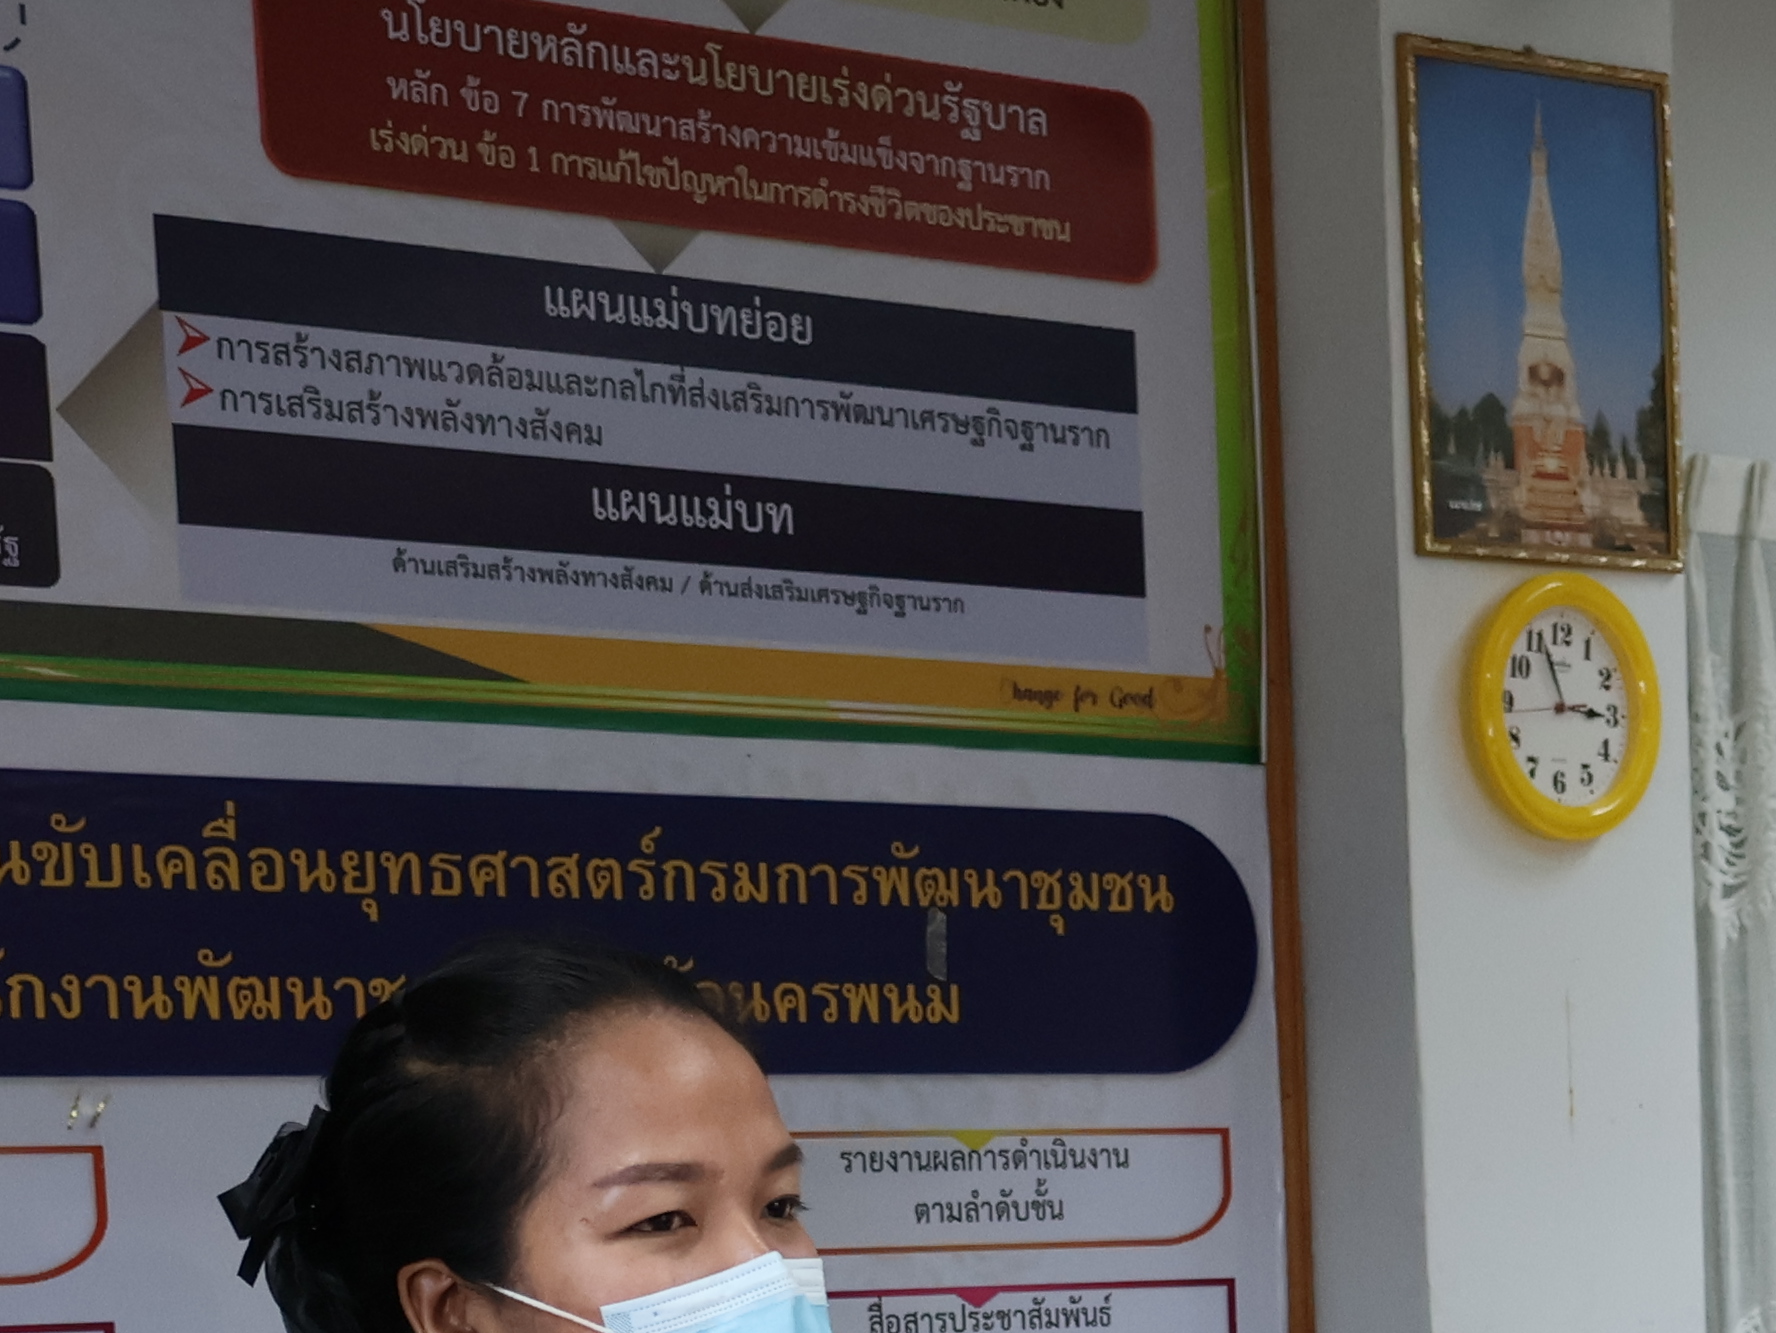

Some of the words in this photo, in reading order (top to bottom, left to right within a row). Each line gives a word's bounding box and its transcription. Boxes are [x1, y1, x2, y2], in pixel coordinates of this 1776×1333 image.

[387, 70, 449, 110] หลัก
[460, 78, 500, 116] ข้อ
[513, 90, 529, 118] 7
[369, 122, 468, 167] เร่งด่วน
[476, 130, 516, 170] ข้อ
[528, 146, 539, 173] 1
[542, 279, 815, 346] แผนแม่บทย่อย
[219, 380, 604, 448] การเสริมสร้างพลังทางสังคม
[591, 482, 794, 537] แผนแม่บท
[1550, 621, 1574, 647] 12
[1509, 653, 1532, 680] 10
[1598, 666, 1613, 692] 2
[1605, 703, 1619, 729] 3
[1596, 737, 1611, 763] 4
[1552, 768, 1567, 795] 6
[1579, 762, 1594, 788] 5
[840, 1136, 1131, 1175] รายงานผลการดำเนินงาน
[915, 1182, 1066, 1225] ตามลำดับขั้น
